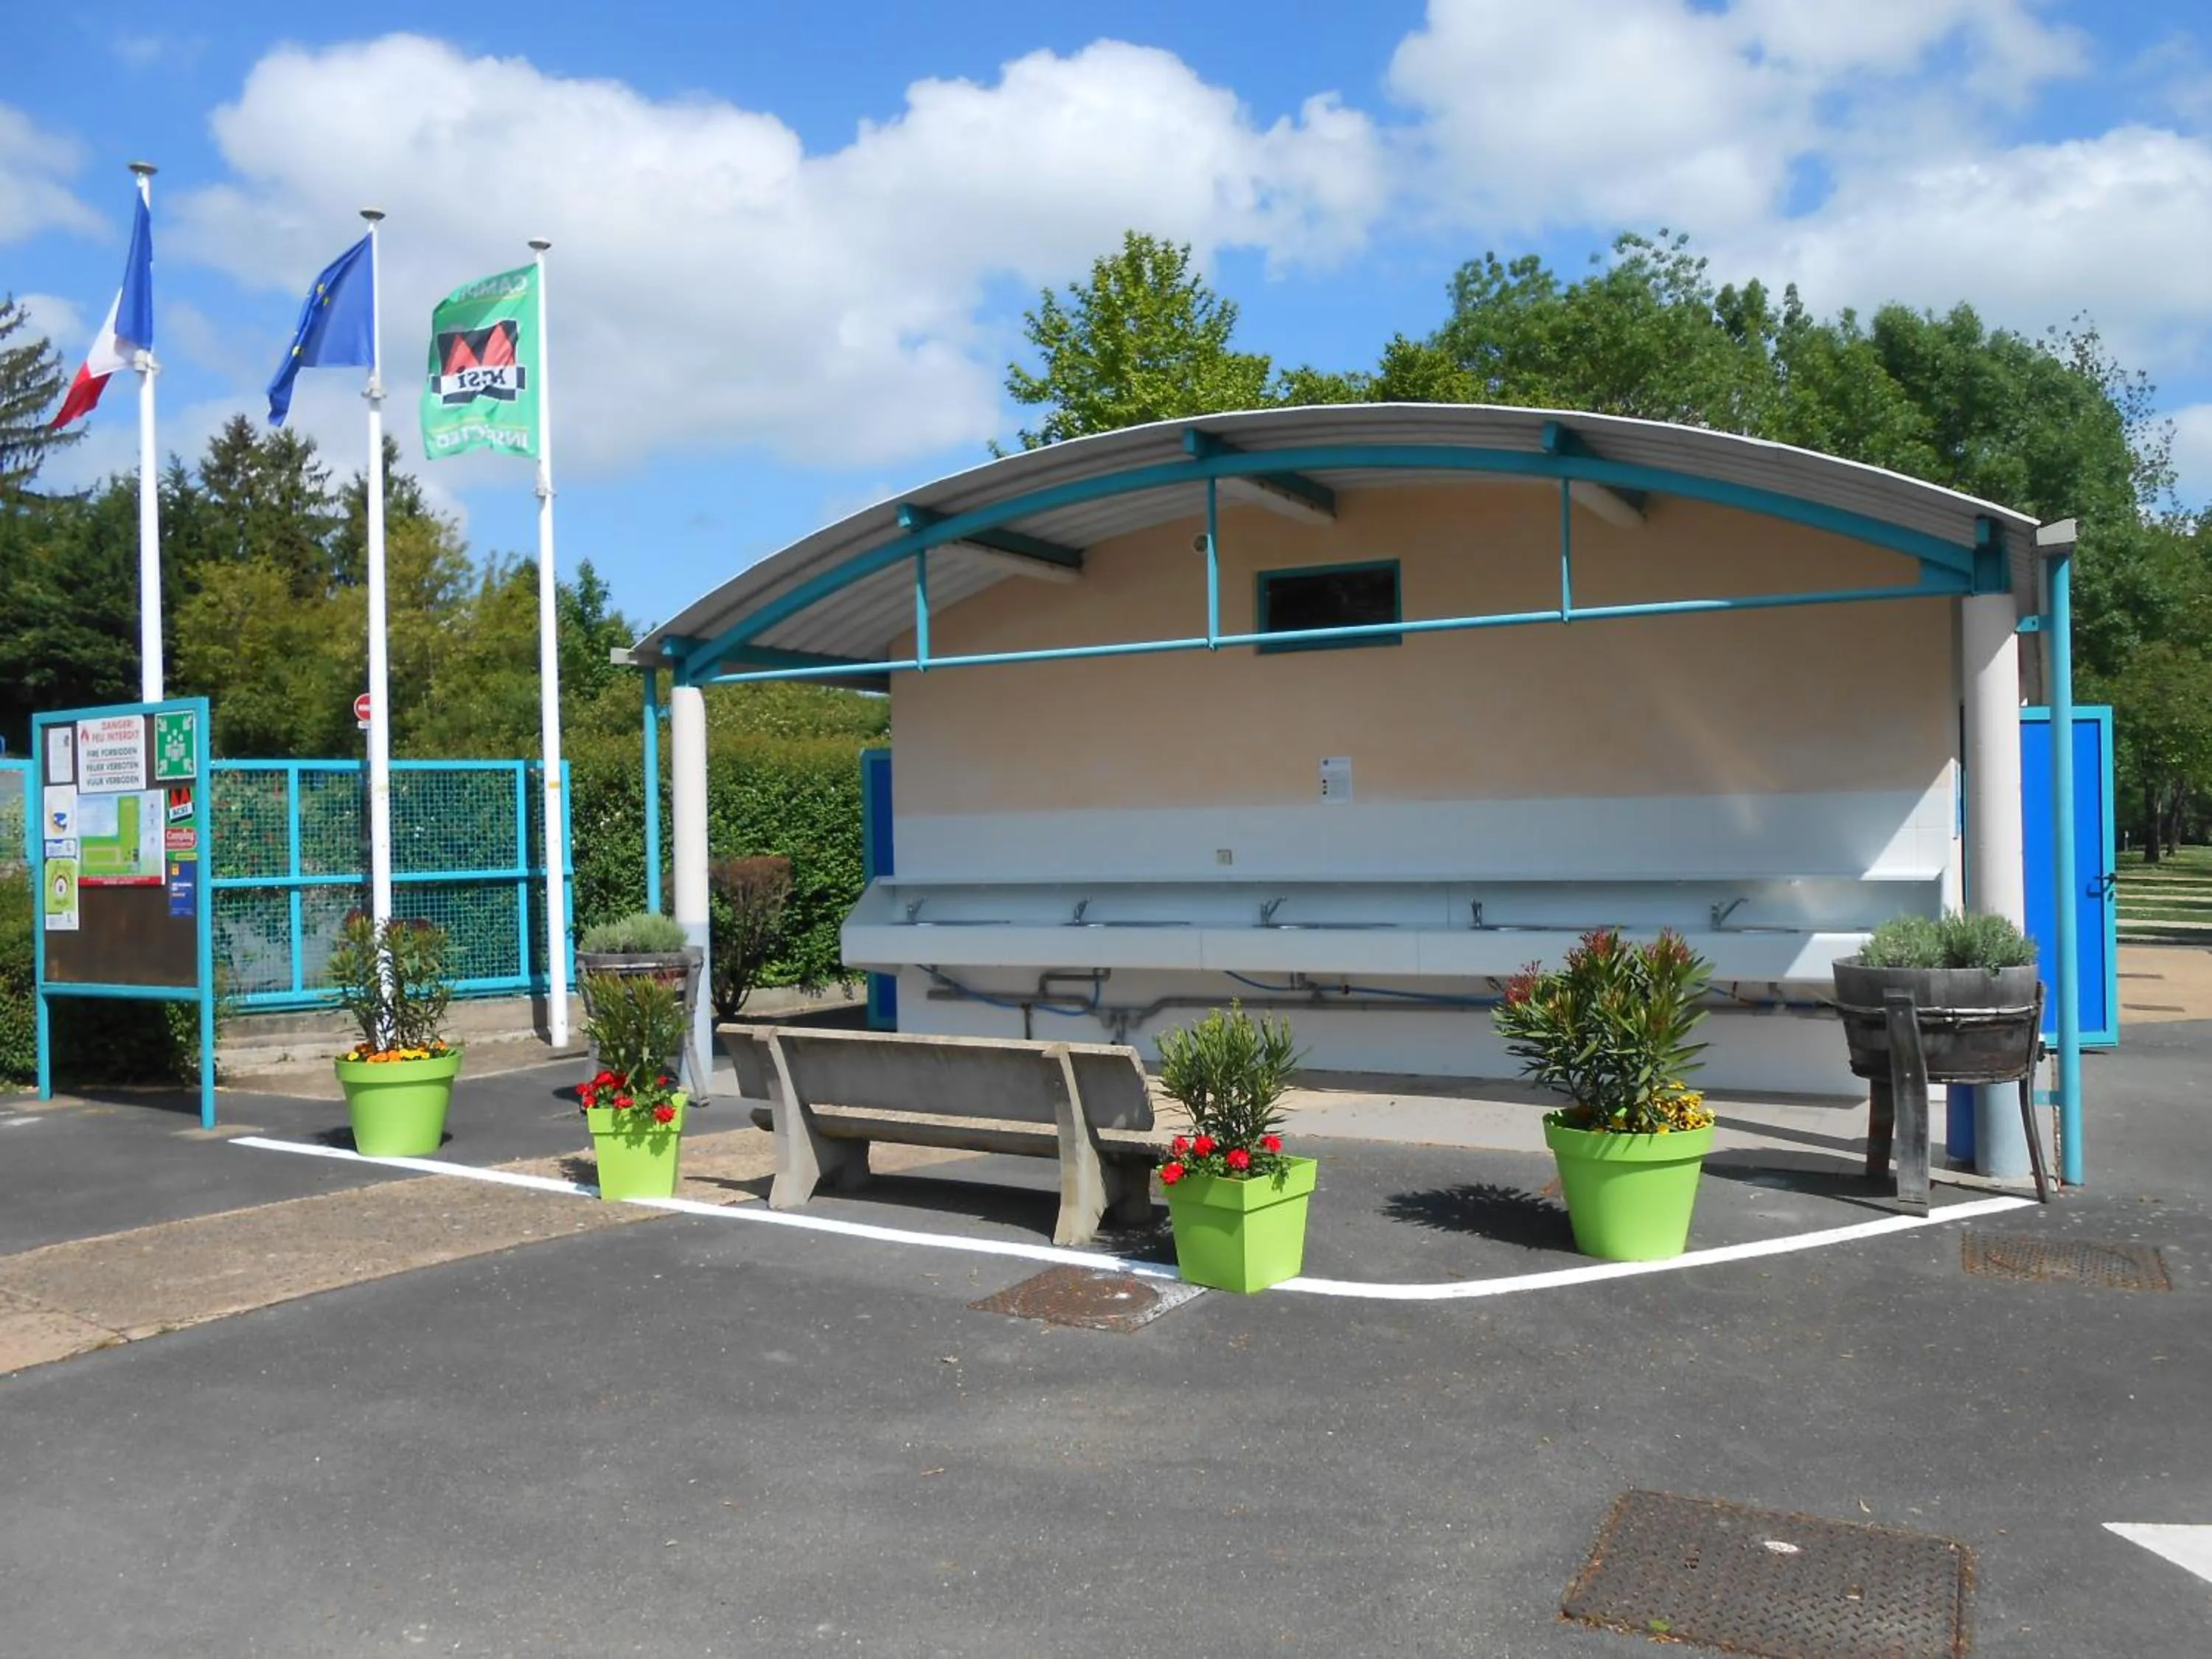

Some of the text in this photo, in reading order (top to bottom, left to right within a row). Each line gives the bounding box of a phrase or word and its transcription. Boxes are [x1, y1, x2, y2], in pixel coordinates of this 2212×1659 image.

[86, 747, 138, 758] FIRE FORBIDDEN
[86, 760, 139, 773] FEUER VERBOTEN
[86, 775, 139, 787] VUUR VERBODEN
